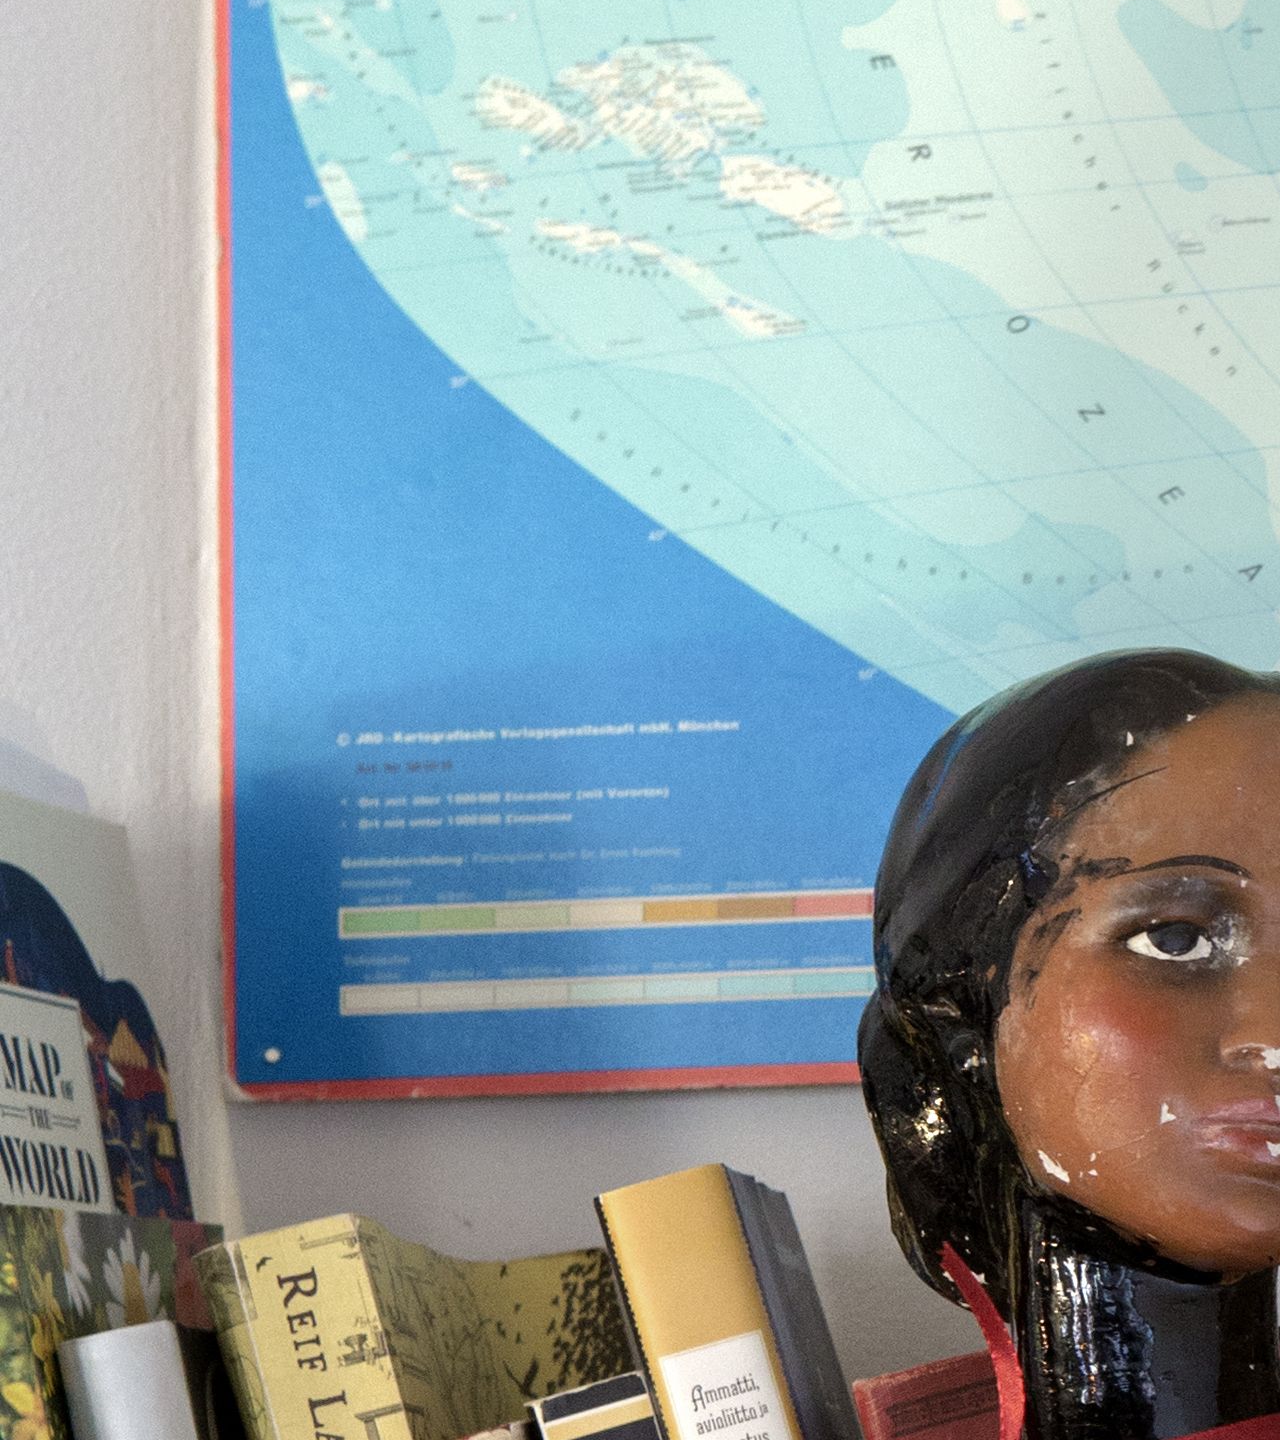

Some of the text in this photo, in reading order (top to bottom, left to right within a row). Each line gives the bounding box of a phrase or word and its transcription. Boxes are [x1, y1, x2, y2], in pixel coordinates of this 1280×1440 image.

[0, 1032, 60, 1096] MAP
[27, 1105, 52, 1130] THE
[0, 1139, 101, 1205] WORLD
[276, 1265, 330, 1376] REIF
[689, 1375, 761, 1414] Ammatti,
[694, 1400, 770, 1439] avioliitto ja
